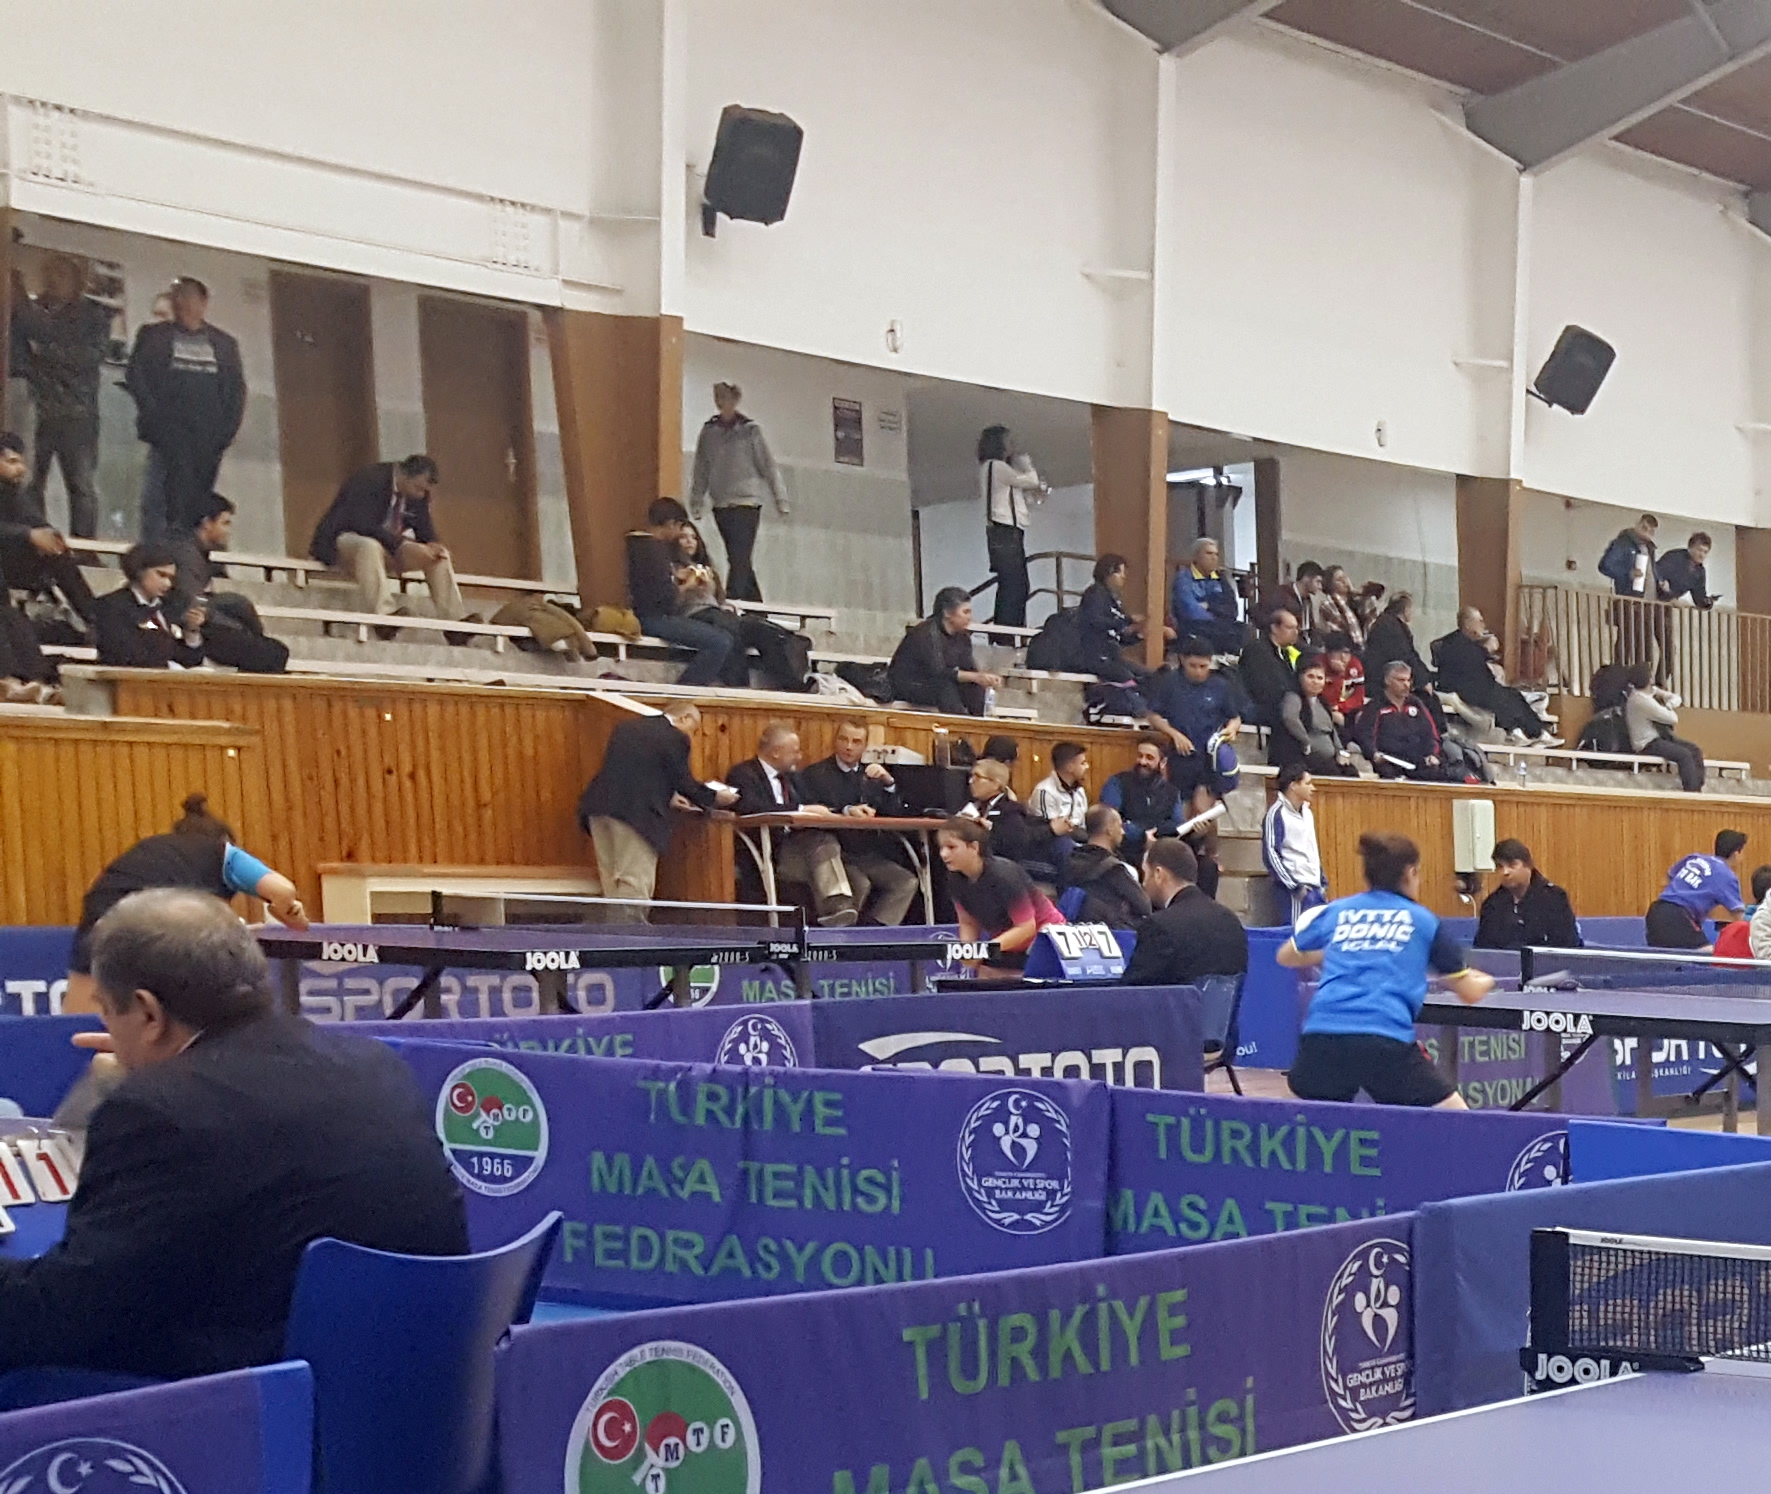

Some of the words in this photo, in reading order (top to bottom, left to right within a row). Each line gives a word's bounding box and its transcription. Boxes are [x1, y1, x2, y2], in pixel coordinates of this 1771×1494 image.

[321, 942, 379, 964] JOOLA
[947, 943, 989, 959] JOOLA
[1057, 931, 1070, 955] 7
[1099, 931, 1113, 955] 7
[525, 950, 580, 971] JOOLA
[300, 973, 614, 1022] SPORTOO
[741, 979, 796, 1003] MAS
[1522, 1010, 1593, 1034] JOOLA
[1235, 1042, 1258, 1057] ou!
[1146, 1106, 1382, 1177] TÜRKİYE
[470, 1156, 513, 1178] 1966
[738, 1156, 901, 1216] TENİSİ
[903, 1284, 1192, 1400] TÜRKİYE
[1056, 1376, 1257, 1493] TENİSİ
